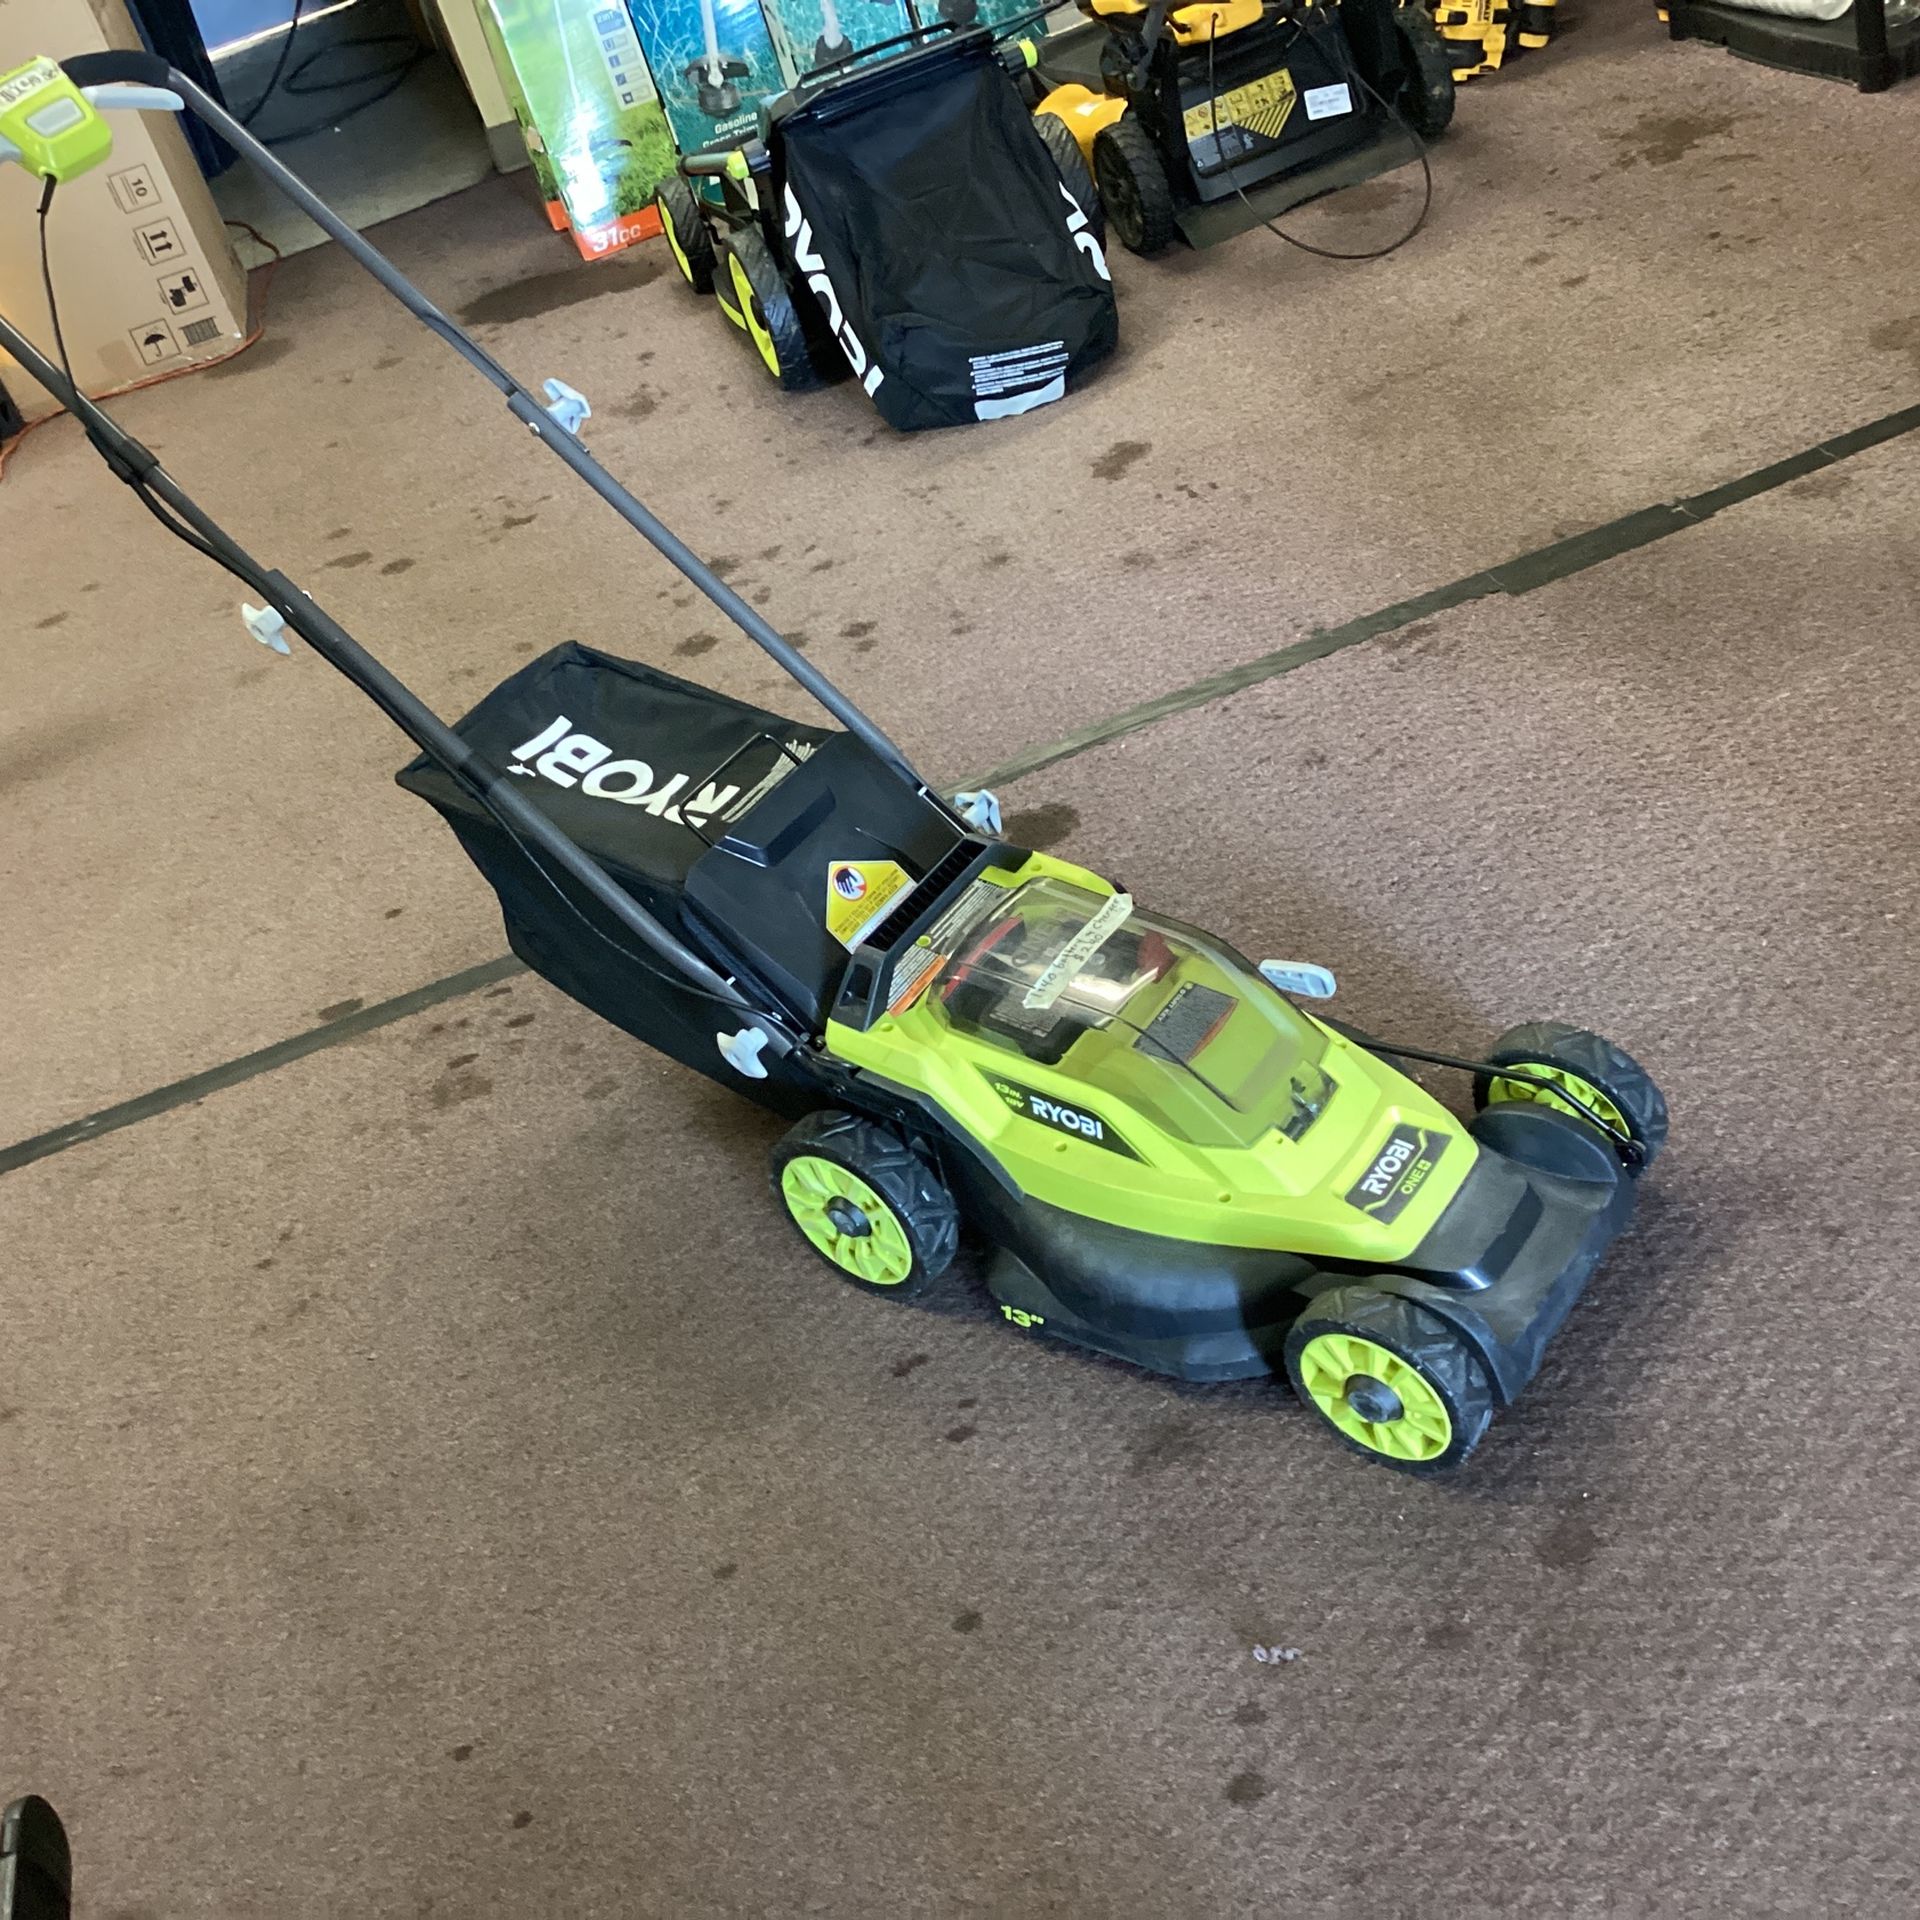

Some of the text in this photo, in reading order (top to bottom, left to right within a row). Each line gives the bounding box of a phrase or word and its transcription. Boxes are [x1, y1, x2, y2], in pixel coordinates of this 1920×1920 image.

[714, 112, 758, 135] Gasoline
[132, 178, 148, 197] 10
[592, 224, 641, 253] 31cc
[511, 714, 741, 829] RYOBI
[1029, 1095, 1104, 1140] RYOBI
[1360, 1138, 1416, 1196] RYOBI
[1000, 1305, 1045, 1328] 13"
